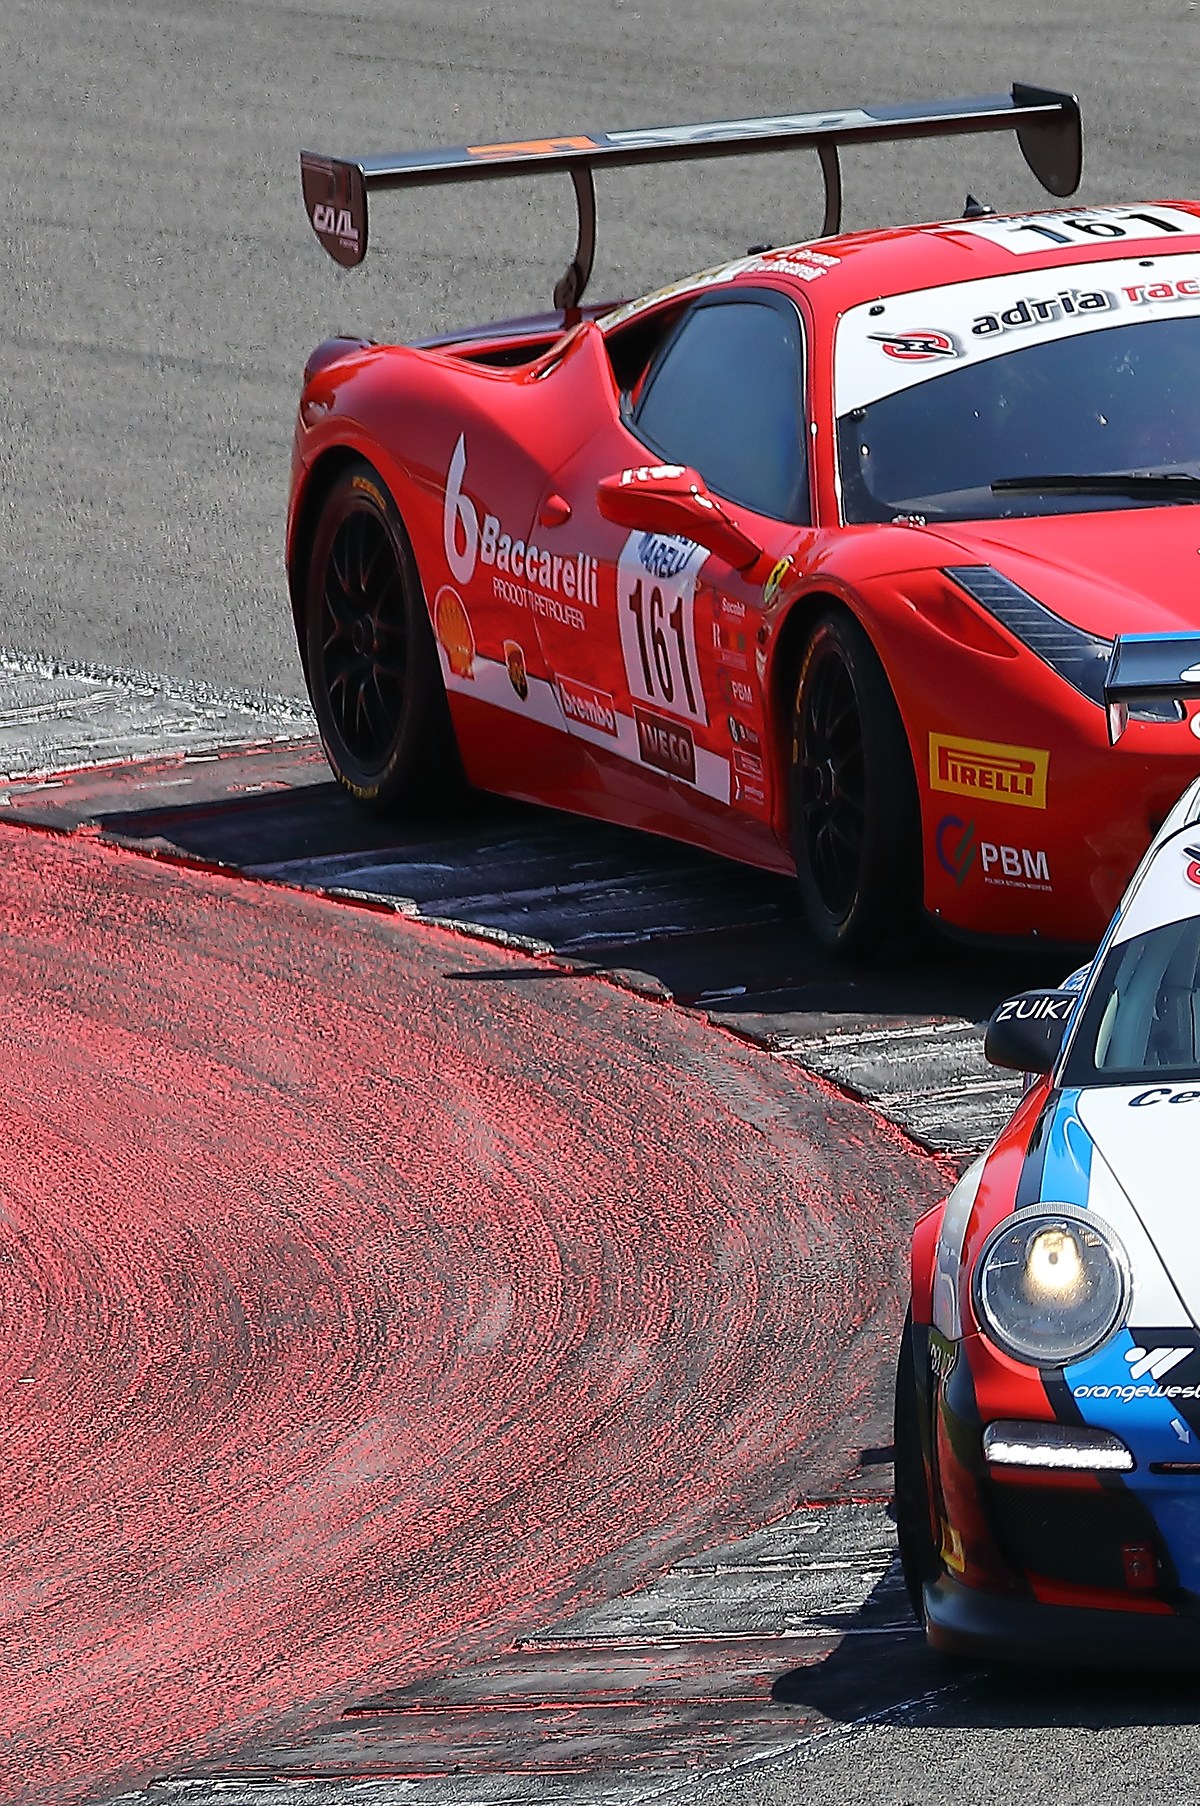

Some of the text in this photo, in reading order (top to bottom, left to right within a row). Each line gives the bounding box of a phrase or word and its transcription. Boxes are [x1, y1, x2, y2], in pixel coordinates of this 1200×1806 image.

[1007, 213, 1184, 244] 161
[972, 289, 1108, 338] adria
[480, 513, 598, 608] Baccarelli
[629, 578, 698, 715] 161
[560, 682, 615, 731] brembo
[640, 721, 691, 764] IVECO
[938, 745, 1036, 796] PIRELLI
[980, 842, 1050, 881] PBM
[996, 996, 1077, 1023] ZUIKI
